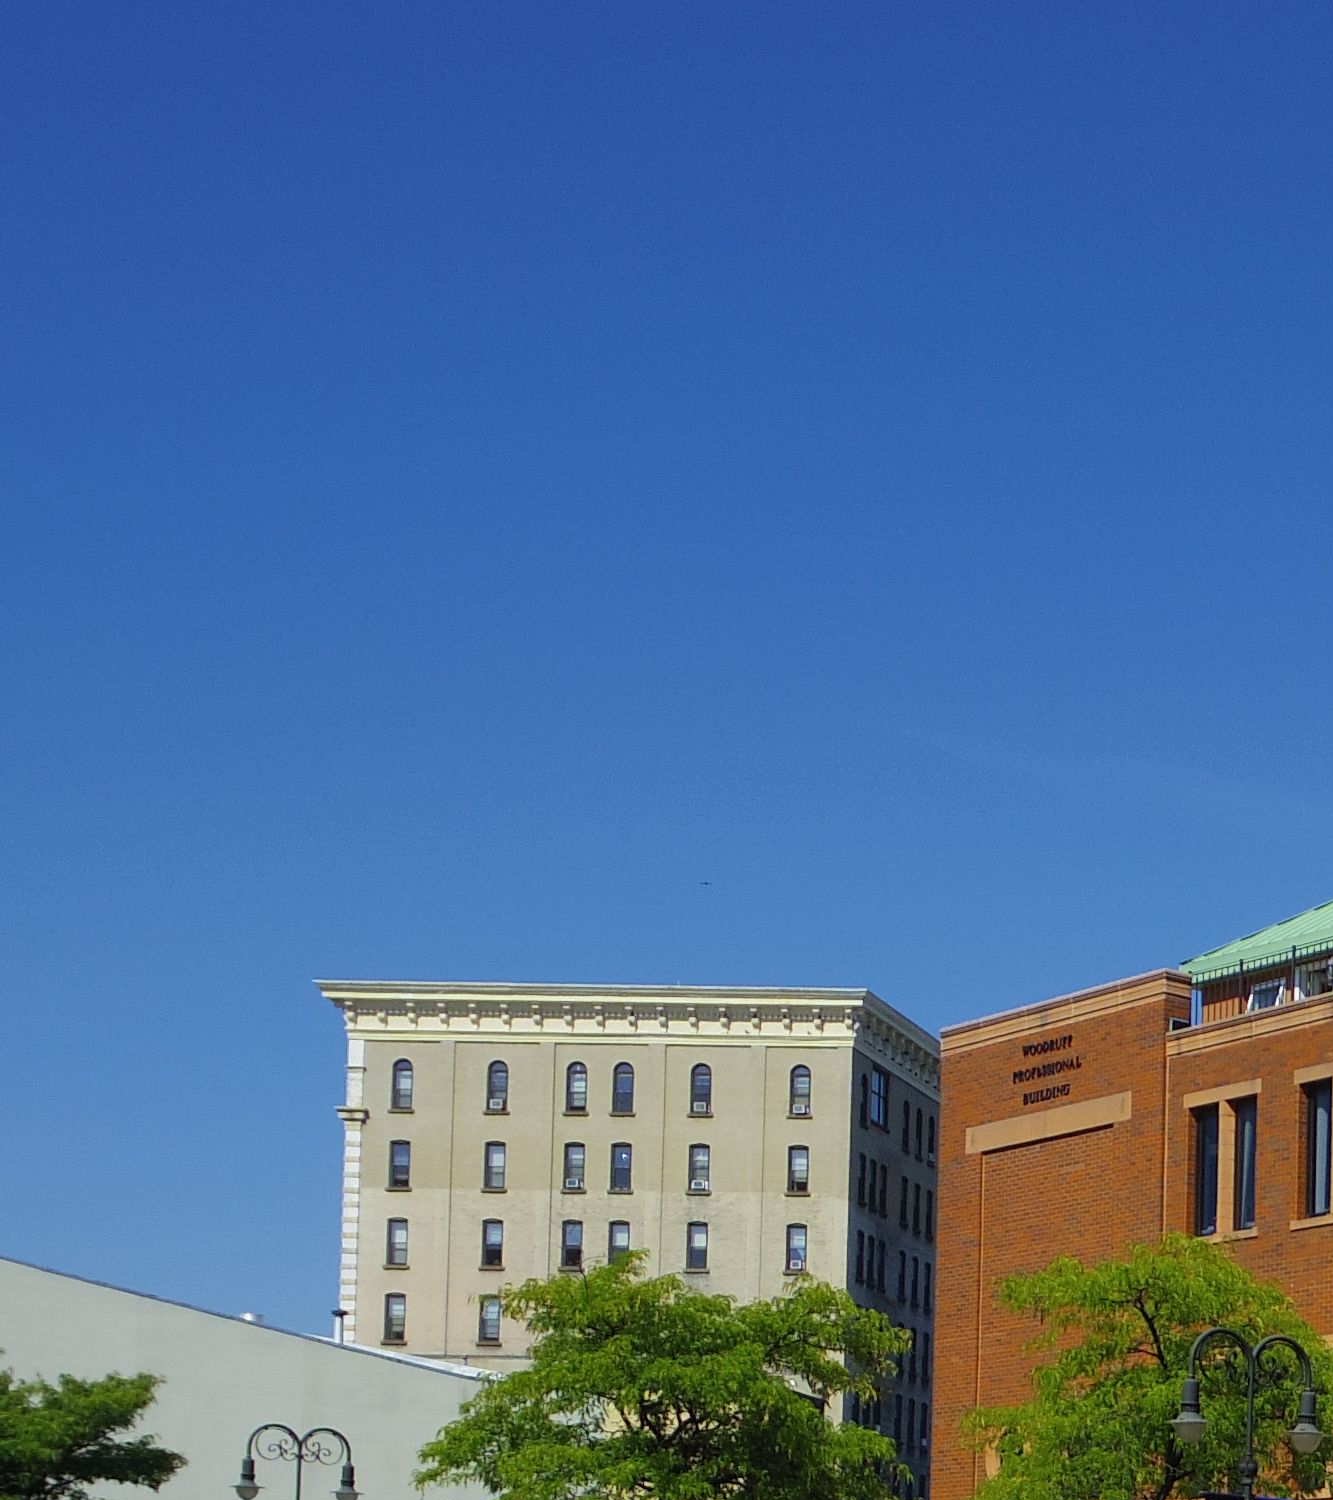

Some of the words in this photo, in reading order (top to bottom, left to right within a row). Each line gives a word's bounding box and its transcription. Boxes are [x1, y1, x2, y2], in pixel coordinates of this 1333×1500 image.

[1022, 1035, 1073, 1057] WOODRUFF
[1012, 1056, 1082, 1084] PROFESSIONAL
[1023, 1084, 1071, 1106] BUILDING
